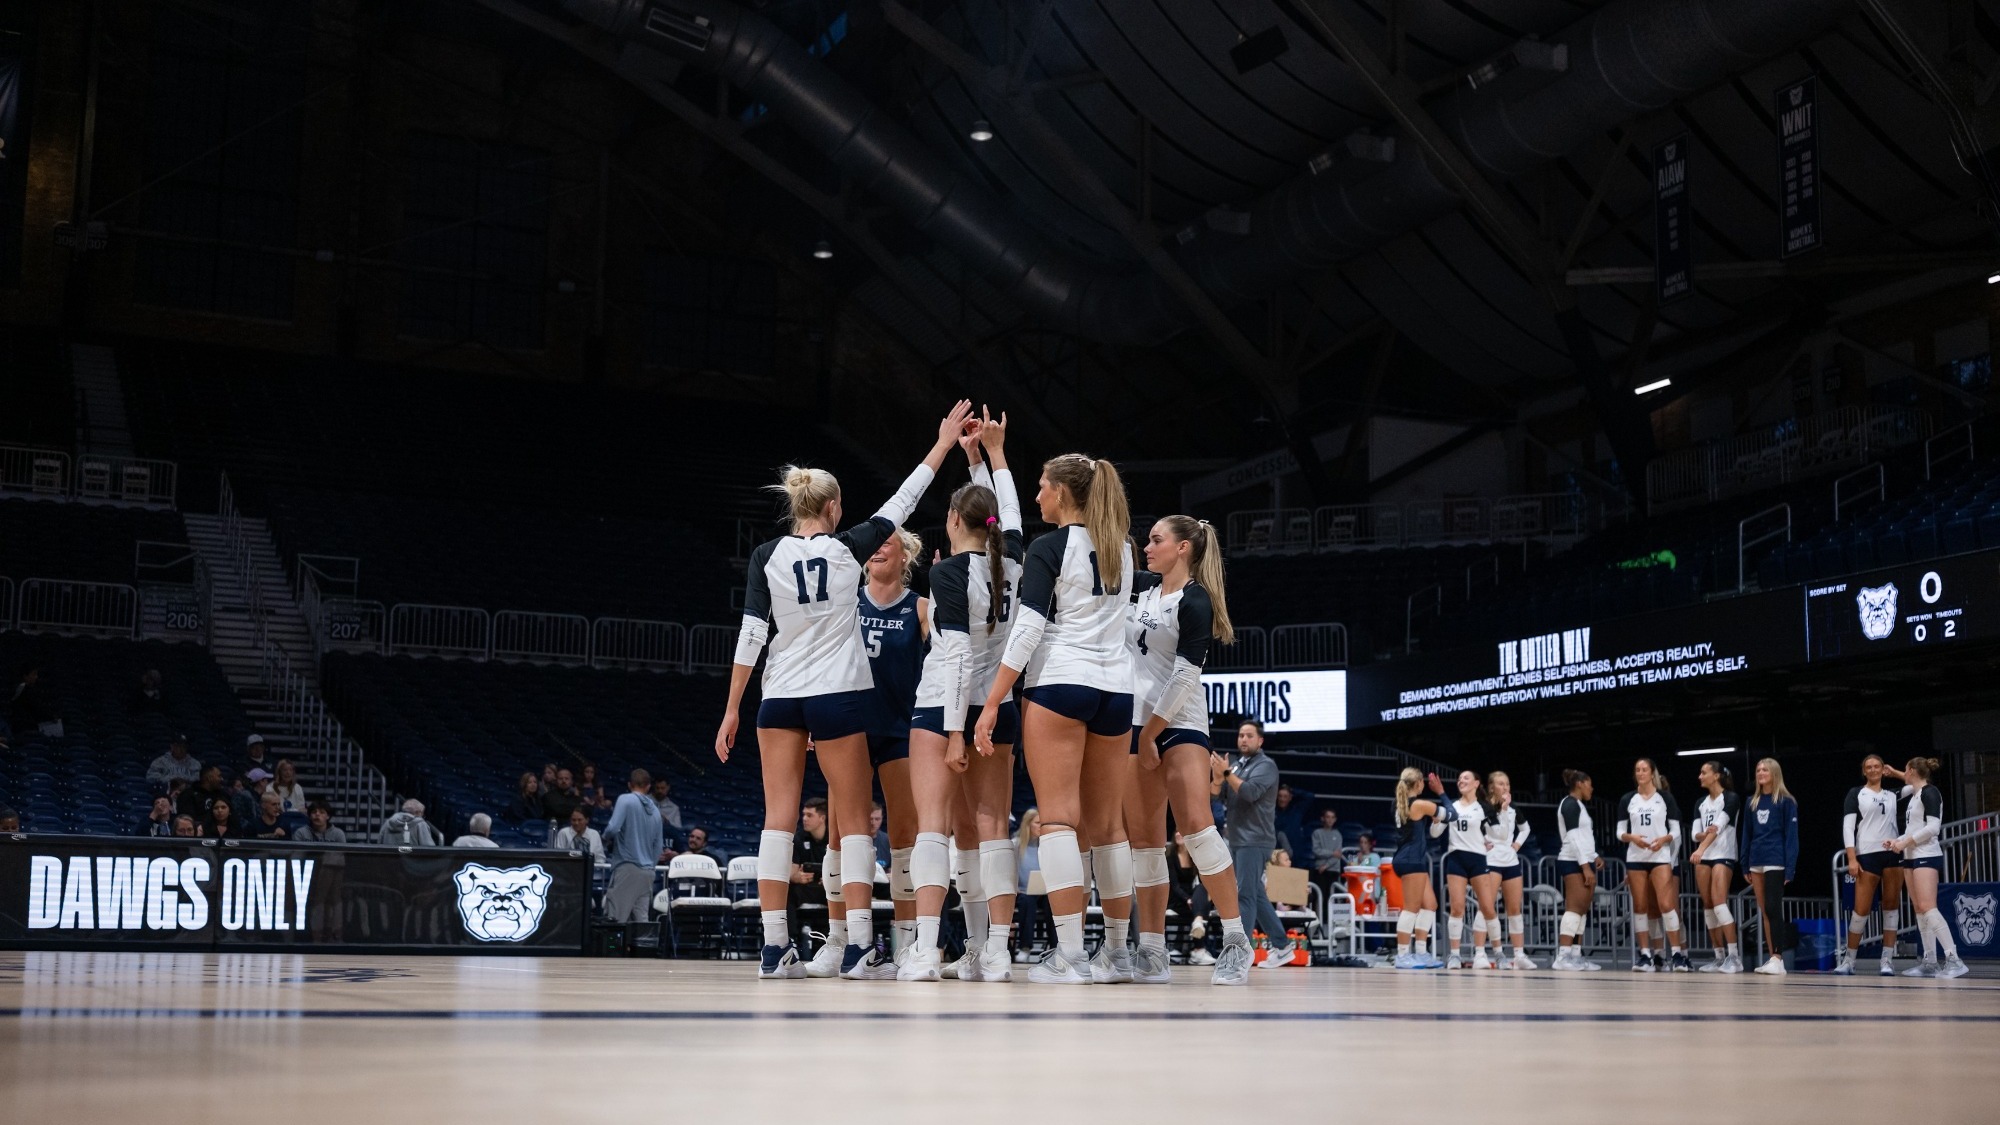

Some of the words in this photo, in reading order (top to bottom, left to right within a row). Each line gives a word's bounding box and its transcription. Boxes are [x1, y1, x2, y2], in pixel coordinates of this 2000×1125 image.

[1781, 102, 1812, 137] WNIT
[1658, 158, 1685, 191] AIAW
[1228, 453, 1297, 487] CONCESSIO
[793, 556, 829, 605] 17
[1089, 551, 1122, 596] 1
[1809, 587, 1828, 598] SCORE
[1828, 586, 1836, 595] BY
[1836, 583, 1847, 593] SET
[1920, 571, 1942, 604] 0
[167, 612, 198, 630] 206
[859, 615, 904, 630] UTLER
[1906, 616, 1919, 624] SETS
[1919, 613, 1933, 621] WON
[1935, 608, 1963, 619] TIMEOUTS
[331, 622, 361, 639] 207
[1915, 624, 1927, 642] 0
[1944, 620, 1956, 638] 2
[866, 630, 884, 659] 5
[1137, 629, 1149, 656] 4
[1498, 640, 1518, 675] THE
[1520, 633, 1560, 672] BUTLER
[1562, 627, 1590, 665] WAY
[1400, 686, 1443, 704] DEMANDS
[1443, 676, 1507, 698] COMMITMENT,
[1508, 670, 1542, 686] DENIES
[1544, 659, 1613, 681] SELFISHNESS,
[1614, 649, 1664, 670] ACCEPTS
[1666, 642, 1715, 662] REALITY,
[1380, 708, 1396, 722] YET
[1397, 705, 1424, 720] SEEKS
[1425, 695, 1489, 716] IMPROVEMENT
[1490, 687, 1539, 706] EVERYDAY
[1539, 683, 1571, 699] WHILE
[1573, 677, 1616, 694] PUTTING
[1617, 672, 1639, 687] THE
[1641, 666, 1672, 684] TEAM
[1674, 661, 1713, 679] ABOVE
[1716, 655, 1748, 673] SELF.
[1878, 802, 1886, 815] 7
[1457, 819, 1468, 832] 18
[1640, 813, 1652, 826] 15
[1705, 814, 1714, 827] 12
[674, 861, 715, 871] BUTLER
[28, 855, 210, 930] DAWGS
[221, 857, 315, 930] ONLY
